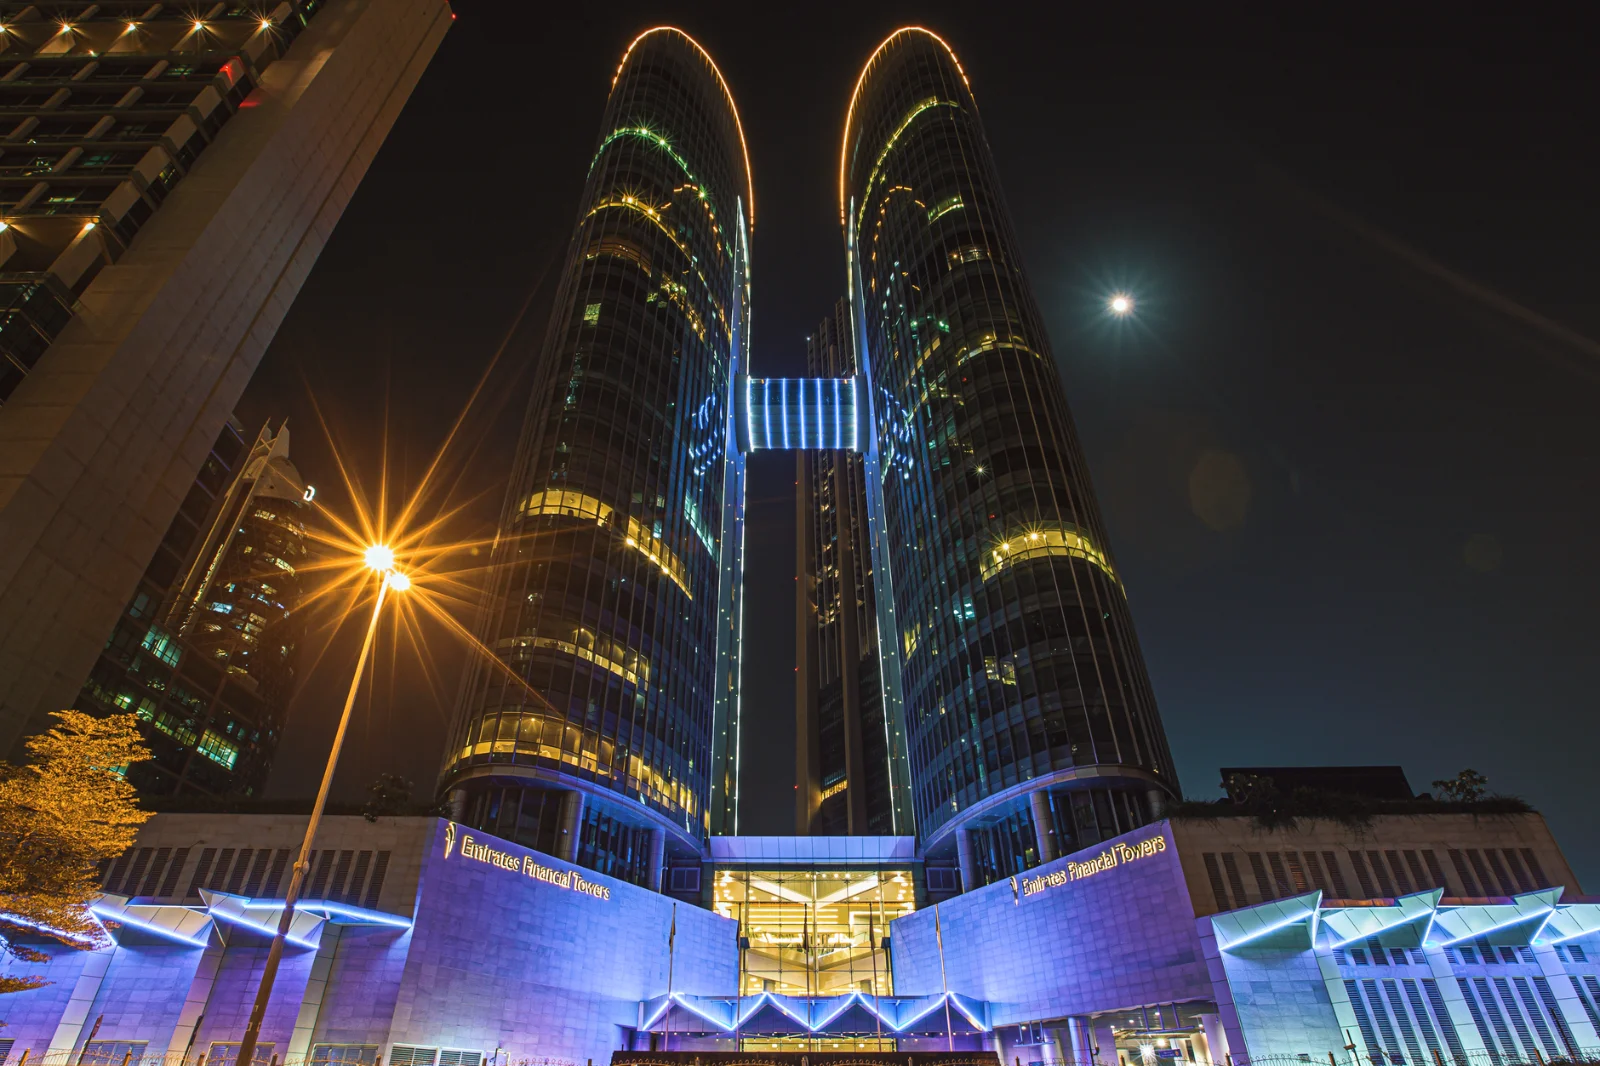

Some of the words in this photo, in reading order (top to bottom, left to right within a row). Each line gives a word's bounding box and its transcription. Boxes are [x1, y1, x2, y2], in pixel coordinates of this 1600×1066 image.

[462, 835, 520, 872] Emirates
[522, 855, 573, 889] Financial
[572, 871, 610, 900] Towers
[1022, 870, 1067, 896] Emirates
[1067, 846, 1118, 881] Financial
[1115, 836, 1166, 864] Towers
